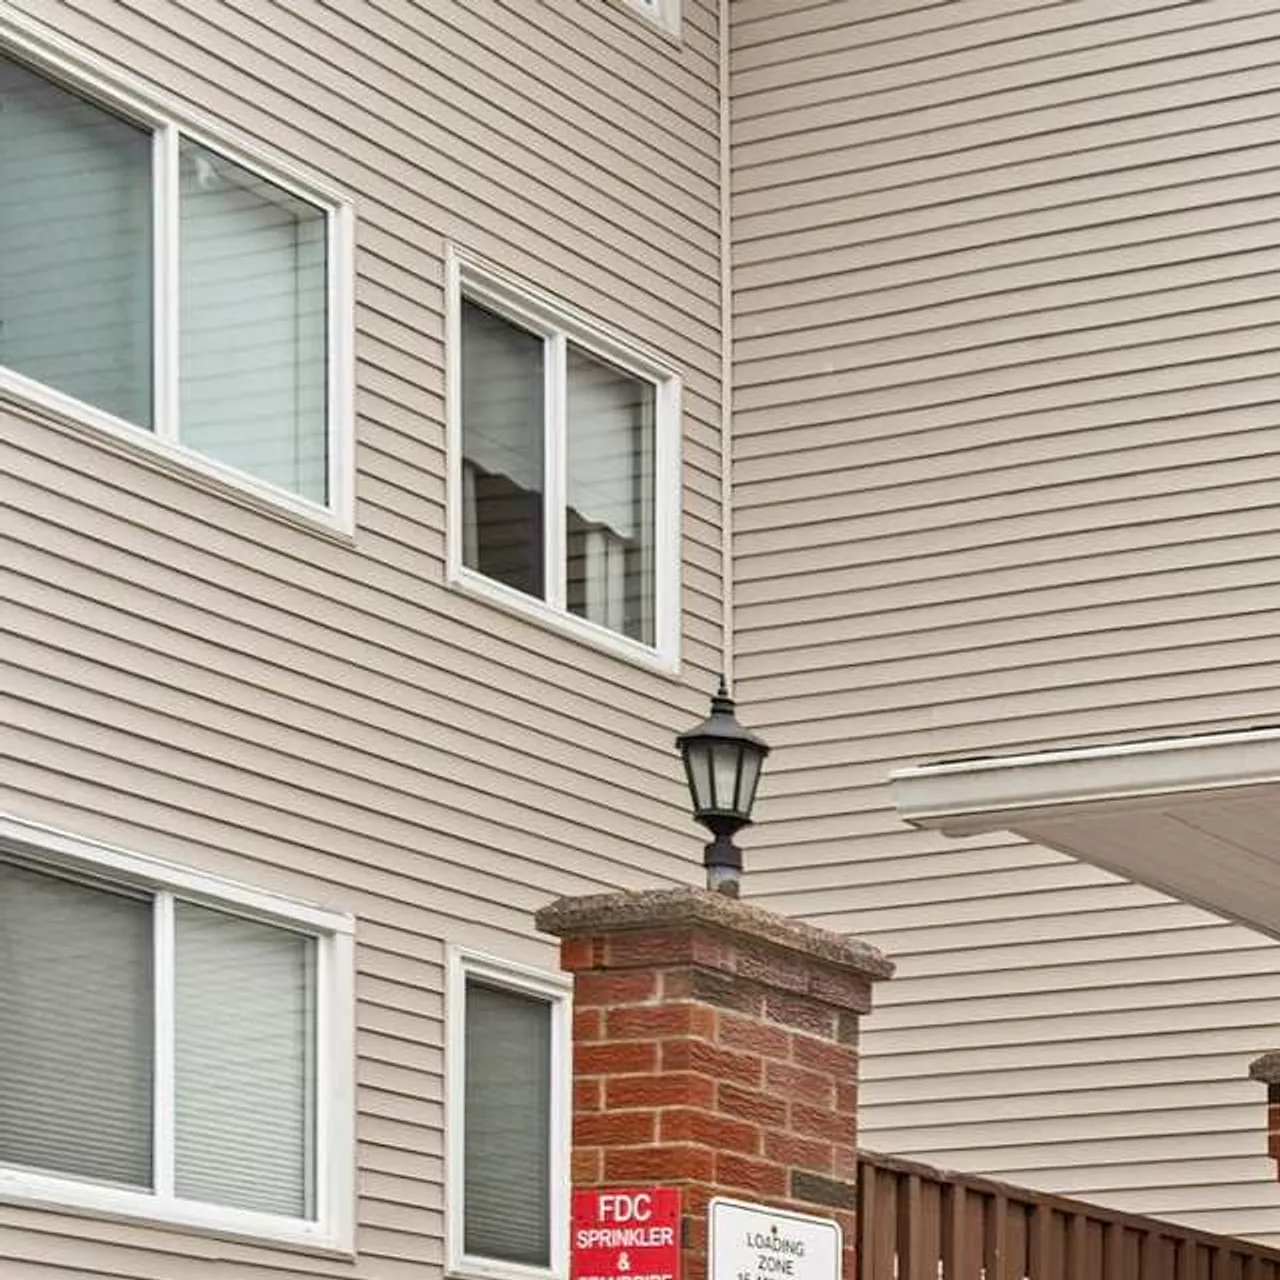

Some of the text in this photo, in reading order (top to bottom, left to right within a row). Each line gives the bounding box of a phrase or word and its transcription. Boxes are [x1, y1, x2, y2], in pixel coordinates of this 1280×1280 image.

[599, 1194, 652, 1222] FDC
[576, 1227, 673, 1249] SPRINKLER
[747, 1233, 804, 1256] LOADING
[617, 1252, 631, 1271] &
[758, 1255, 793, 1275] ZONE
